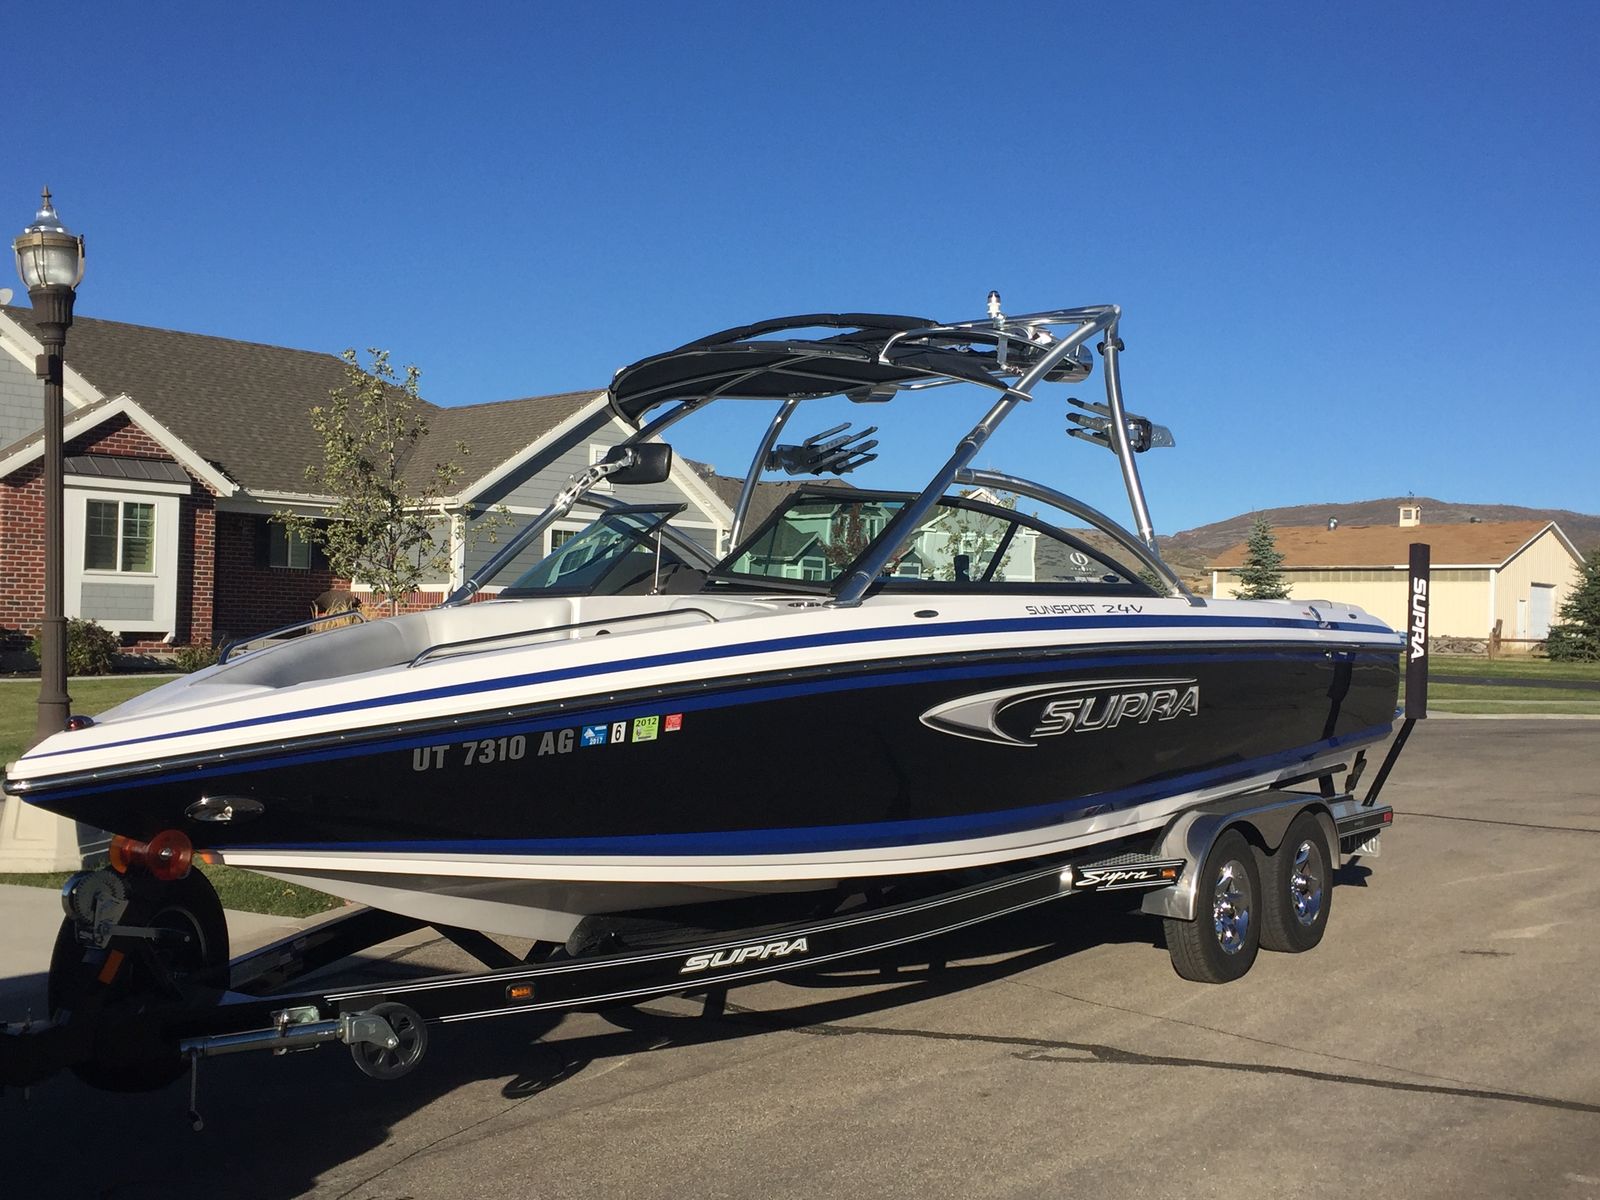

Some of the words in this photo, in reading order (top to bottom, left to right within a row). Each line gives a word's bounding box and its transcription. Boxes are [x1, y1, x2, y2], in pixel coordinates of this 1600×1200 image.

[1025, 603, 1097, 615] SUNSPORT
[1101, 604, 1143, 614] 24V
[1411, 577, 1427, 661] SUPRA
[635, 717, 657, 727] 2012
[1030, 685, 1200, 738] SUPRA
[614, 724, 622, 741] 6
[412, 745, 450, 772] UT
[462, 735, 526, 766] 7310
[537, 728, 575, 757] AG
[1075, 870, 1157, 887] Supra
[680, 937, 808, 973] SUPRA
